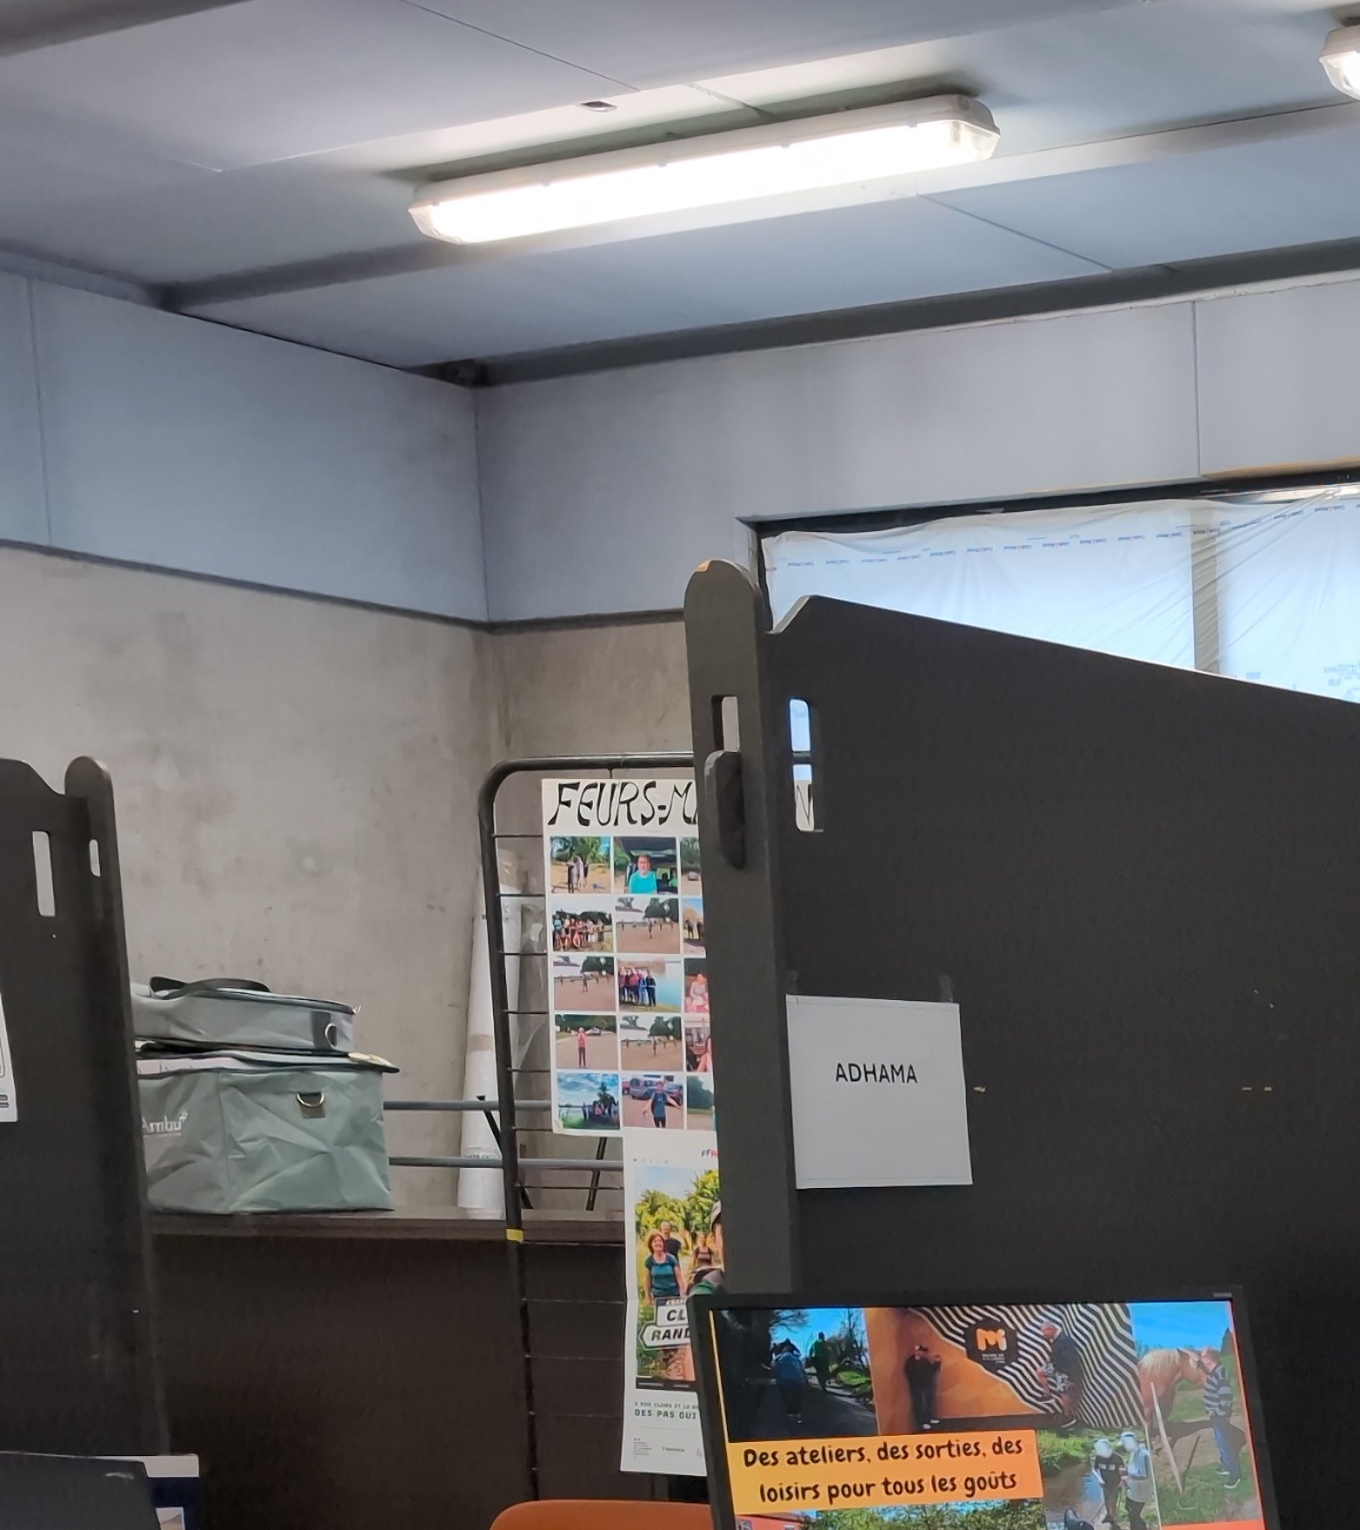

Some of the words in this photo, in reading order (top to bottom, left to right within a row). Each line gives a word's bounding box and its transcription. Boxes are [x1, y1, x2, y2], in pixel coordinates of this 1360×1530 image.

[835, 1061, 918, 1085] ADHAMA
[743, 1448, 780, 1469] Des
[786, 1443, 872, 1468] ateliers,
[876, 1440, 910, 1462] des
[915, 1438, 987, 1461] sorties,
[991, 1436, 1023, 1456] des
[760, 1482, 821, 1504] loisirs
[826, 1478, 877, 1505] pour
[881, 1474, 926, 1496] tous
[931, 1471, 957, 1494] les
[963, 1469, 1018, 1499] goûts
